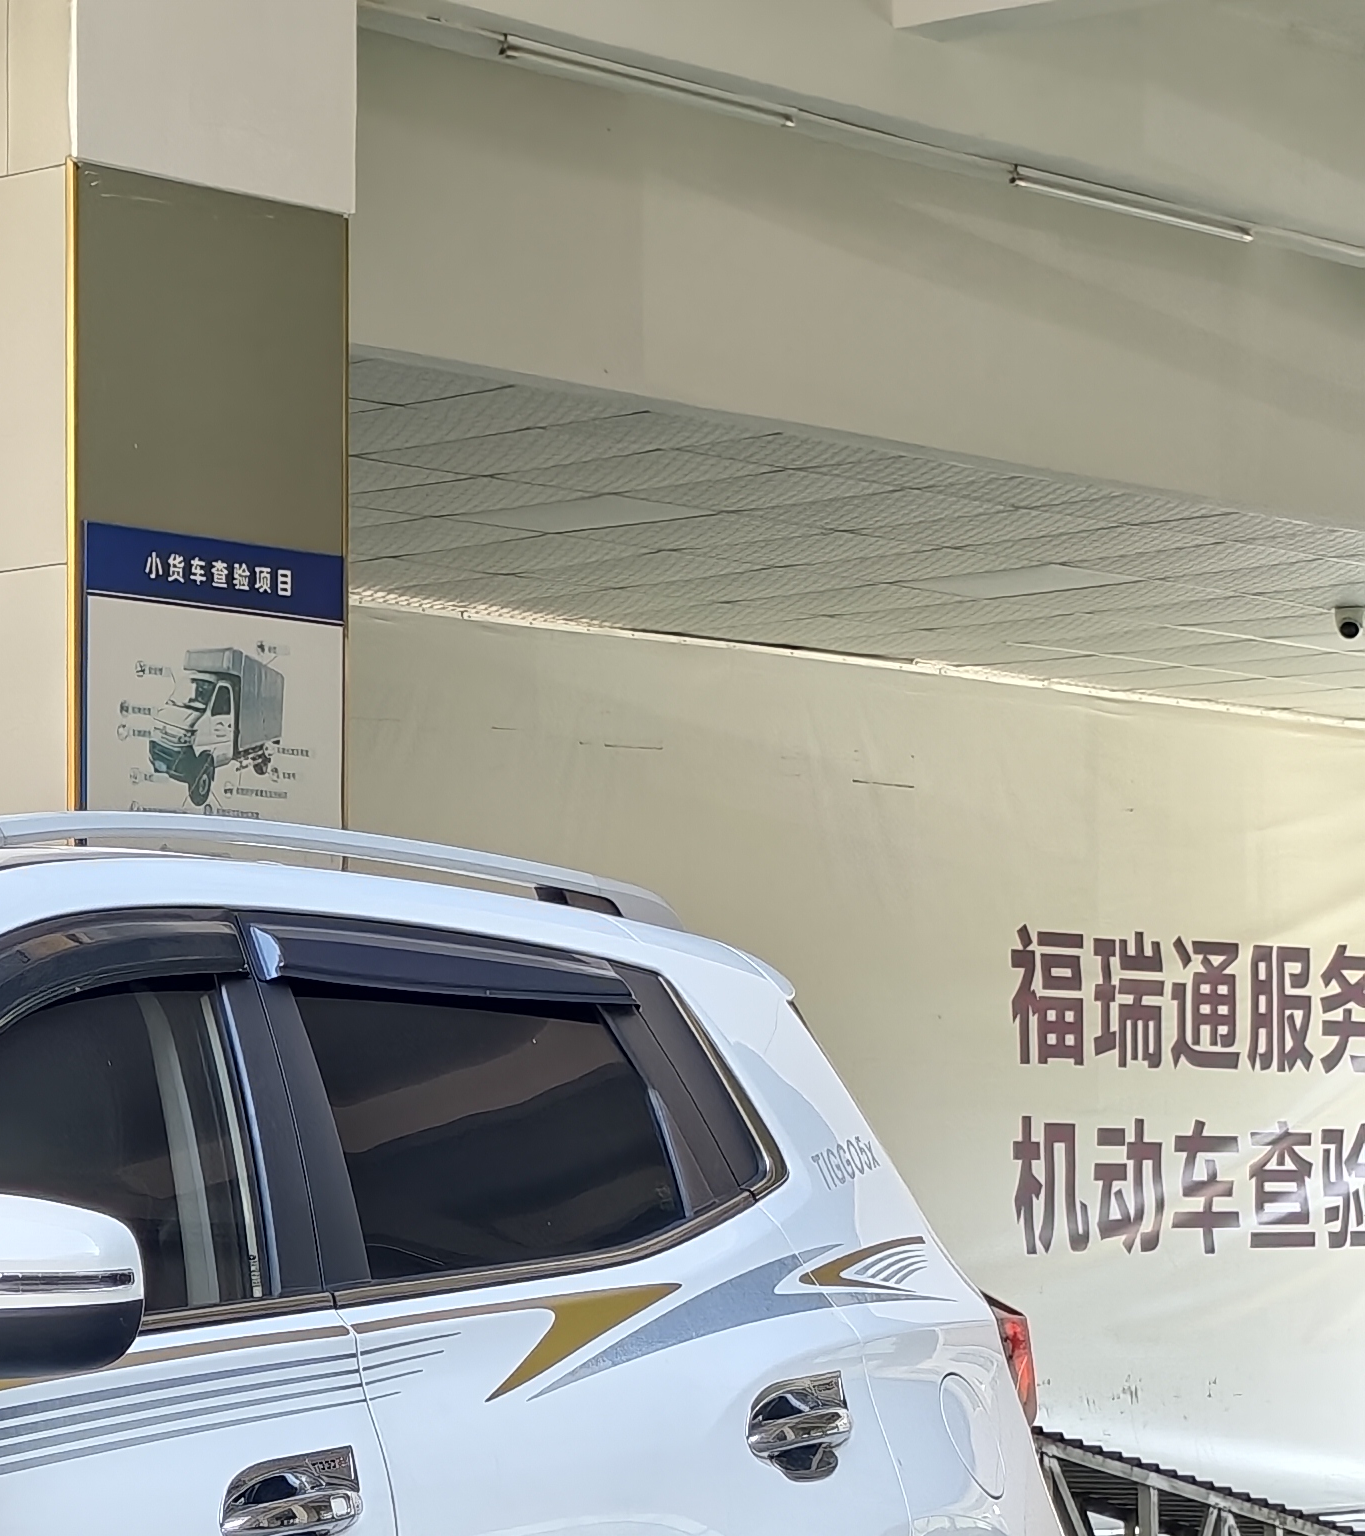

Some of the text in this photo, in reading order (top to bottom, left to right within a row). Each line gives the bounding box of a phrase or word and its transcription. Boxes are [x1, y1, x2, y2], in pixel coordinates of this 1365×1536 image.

[144, 551, 293, 597] 小货车查验项目
[1009, 923, 1365, 1075] 福瑞通服务
[1012, 1114, 1365, 1255] 机动车查验
